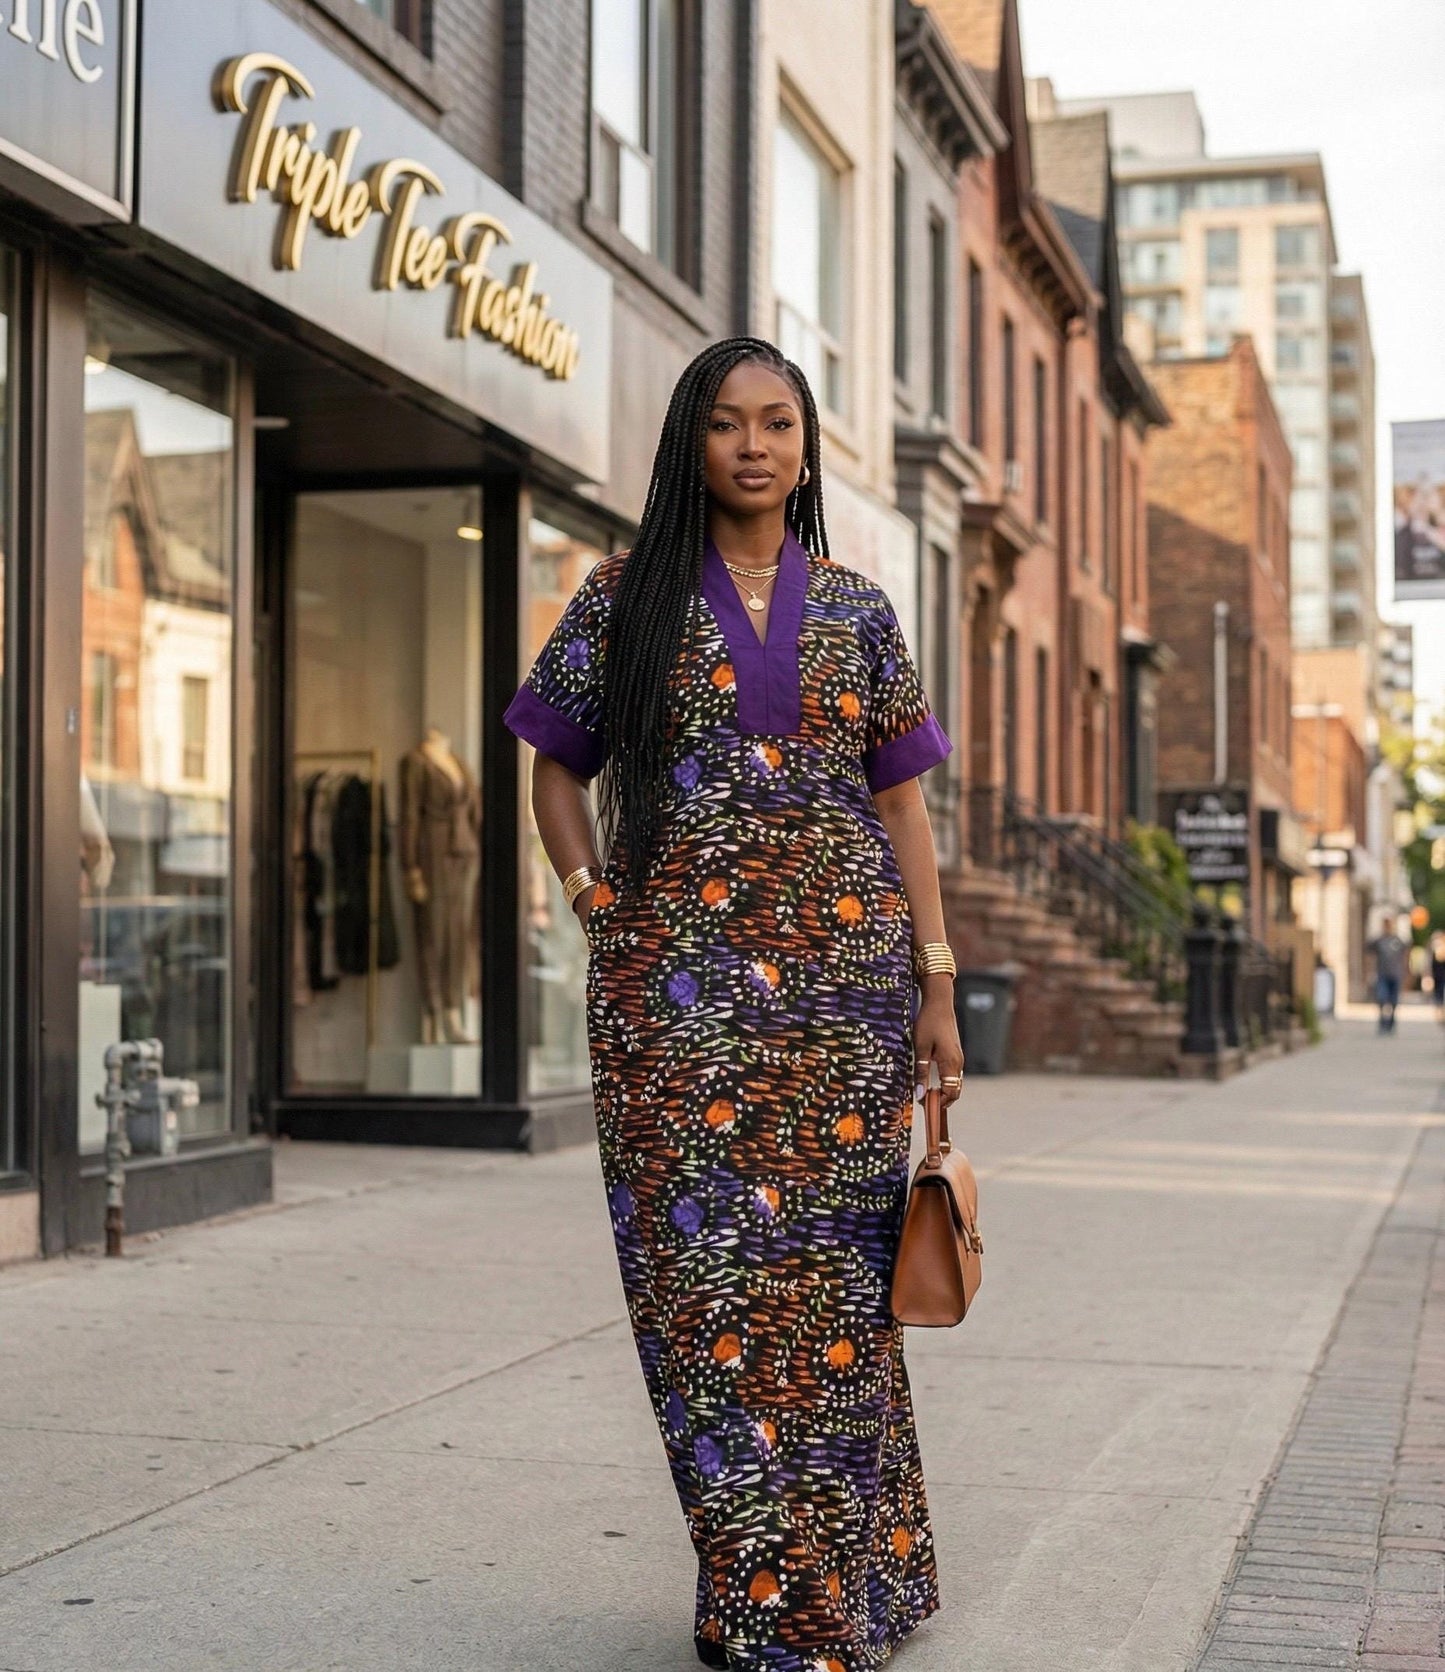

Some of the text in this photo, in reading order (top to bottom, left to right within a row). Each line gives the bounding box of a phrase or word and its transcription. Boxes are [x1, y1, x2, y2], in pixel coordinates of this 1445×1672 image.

[220, 52, 579, 380] Triple Tee Fashion
